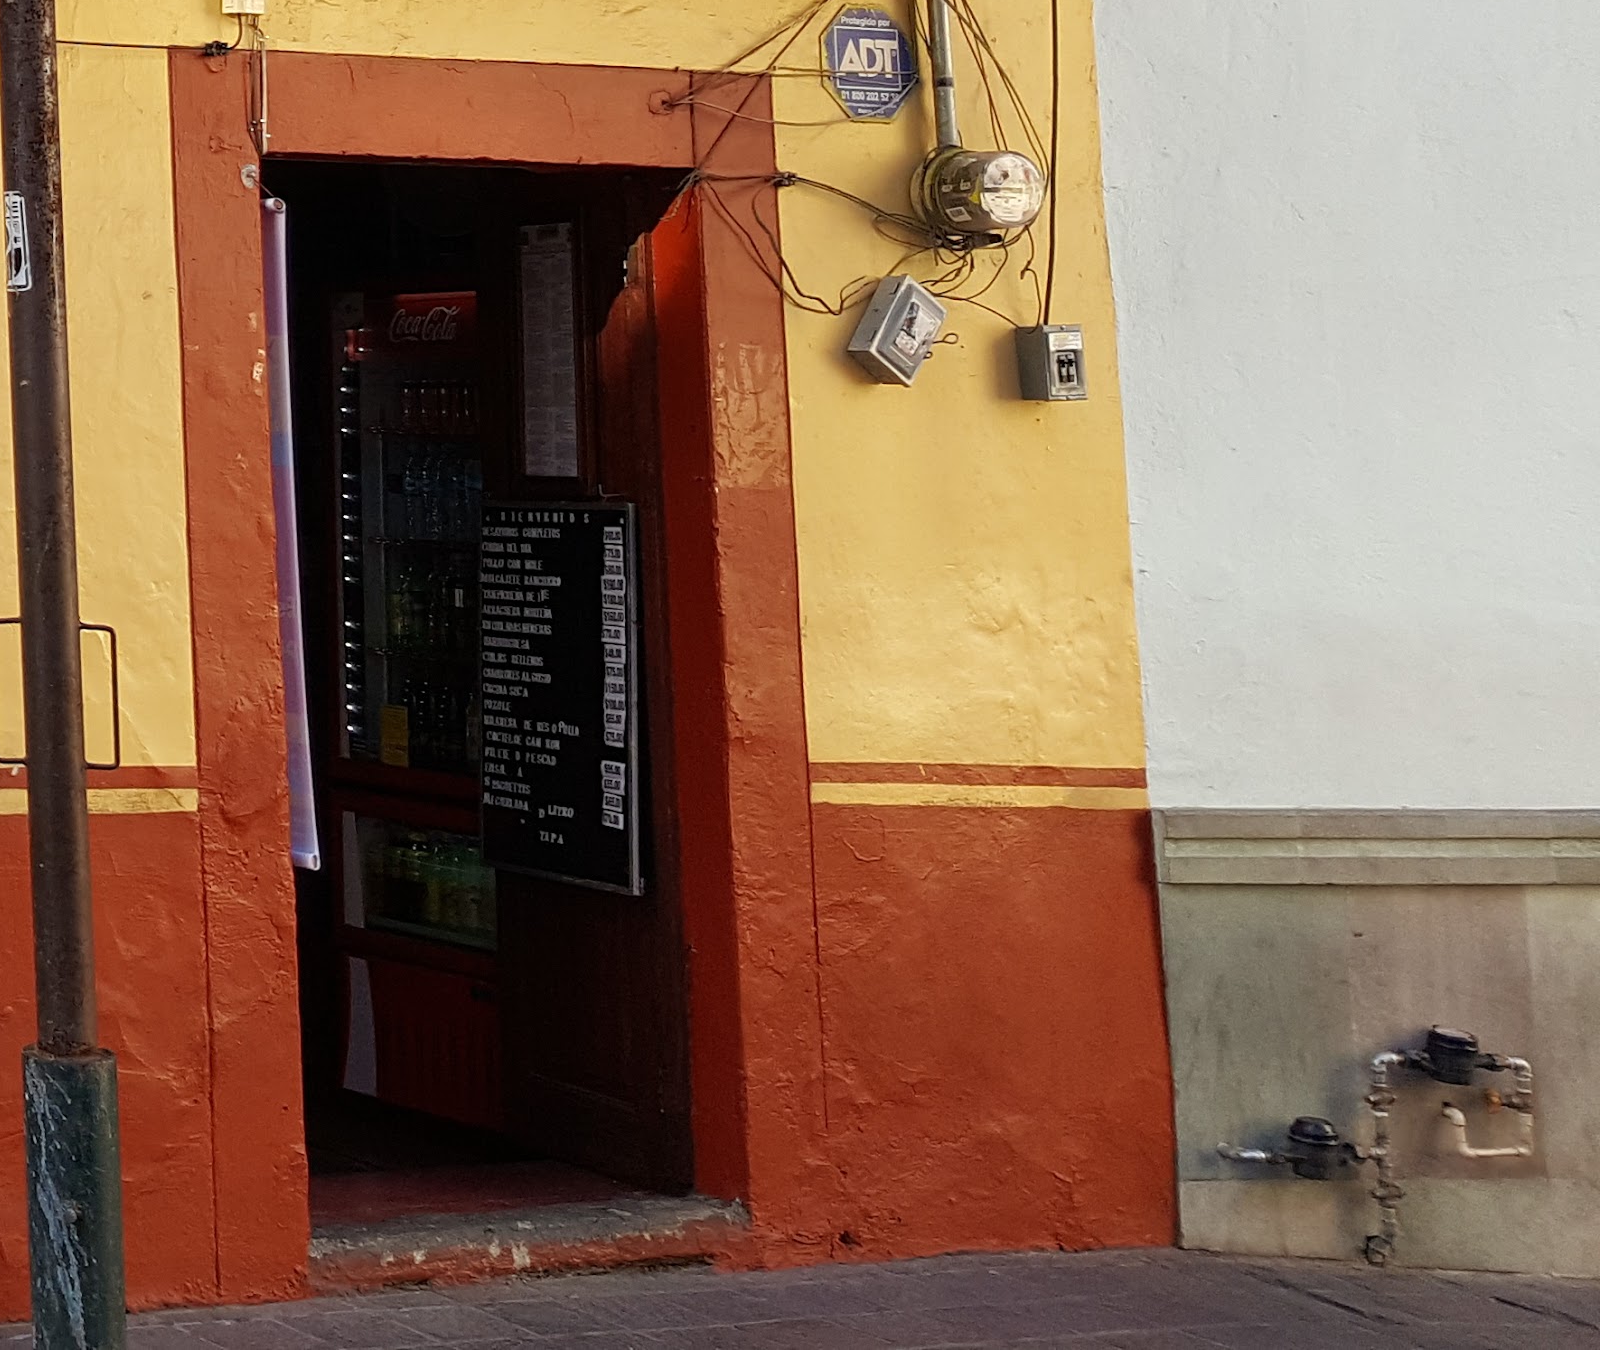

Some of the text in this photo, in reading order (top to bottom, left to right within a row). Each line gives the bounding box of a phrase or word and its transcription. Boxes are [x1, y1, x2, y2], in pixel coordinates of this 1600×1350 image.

[841, 17, 891, 28] Protegido por
[837, 38, 897, 78] ADT
[389, 305, 461, 343] Coca-Cola
[484, 699, 511, 712] POZOLE
